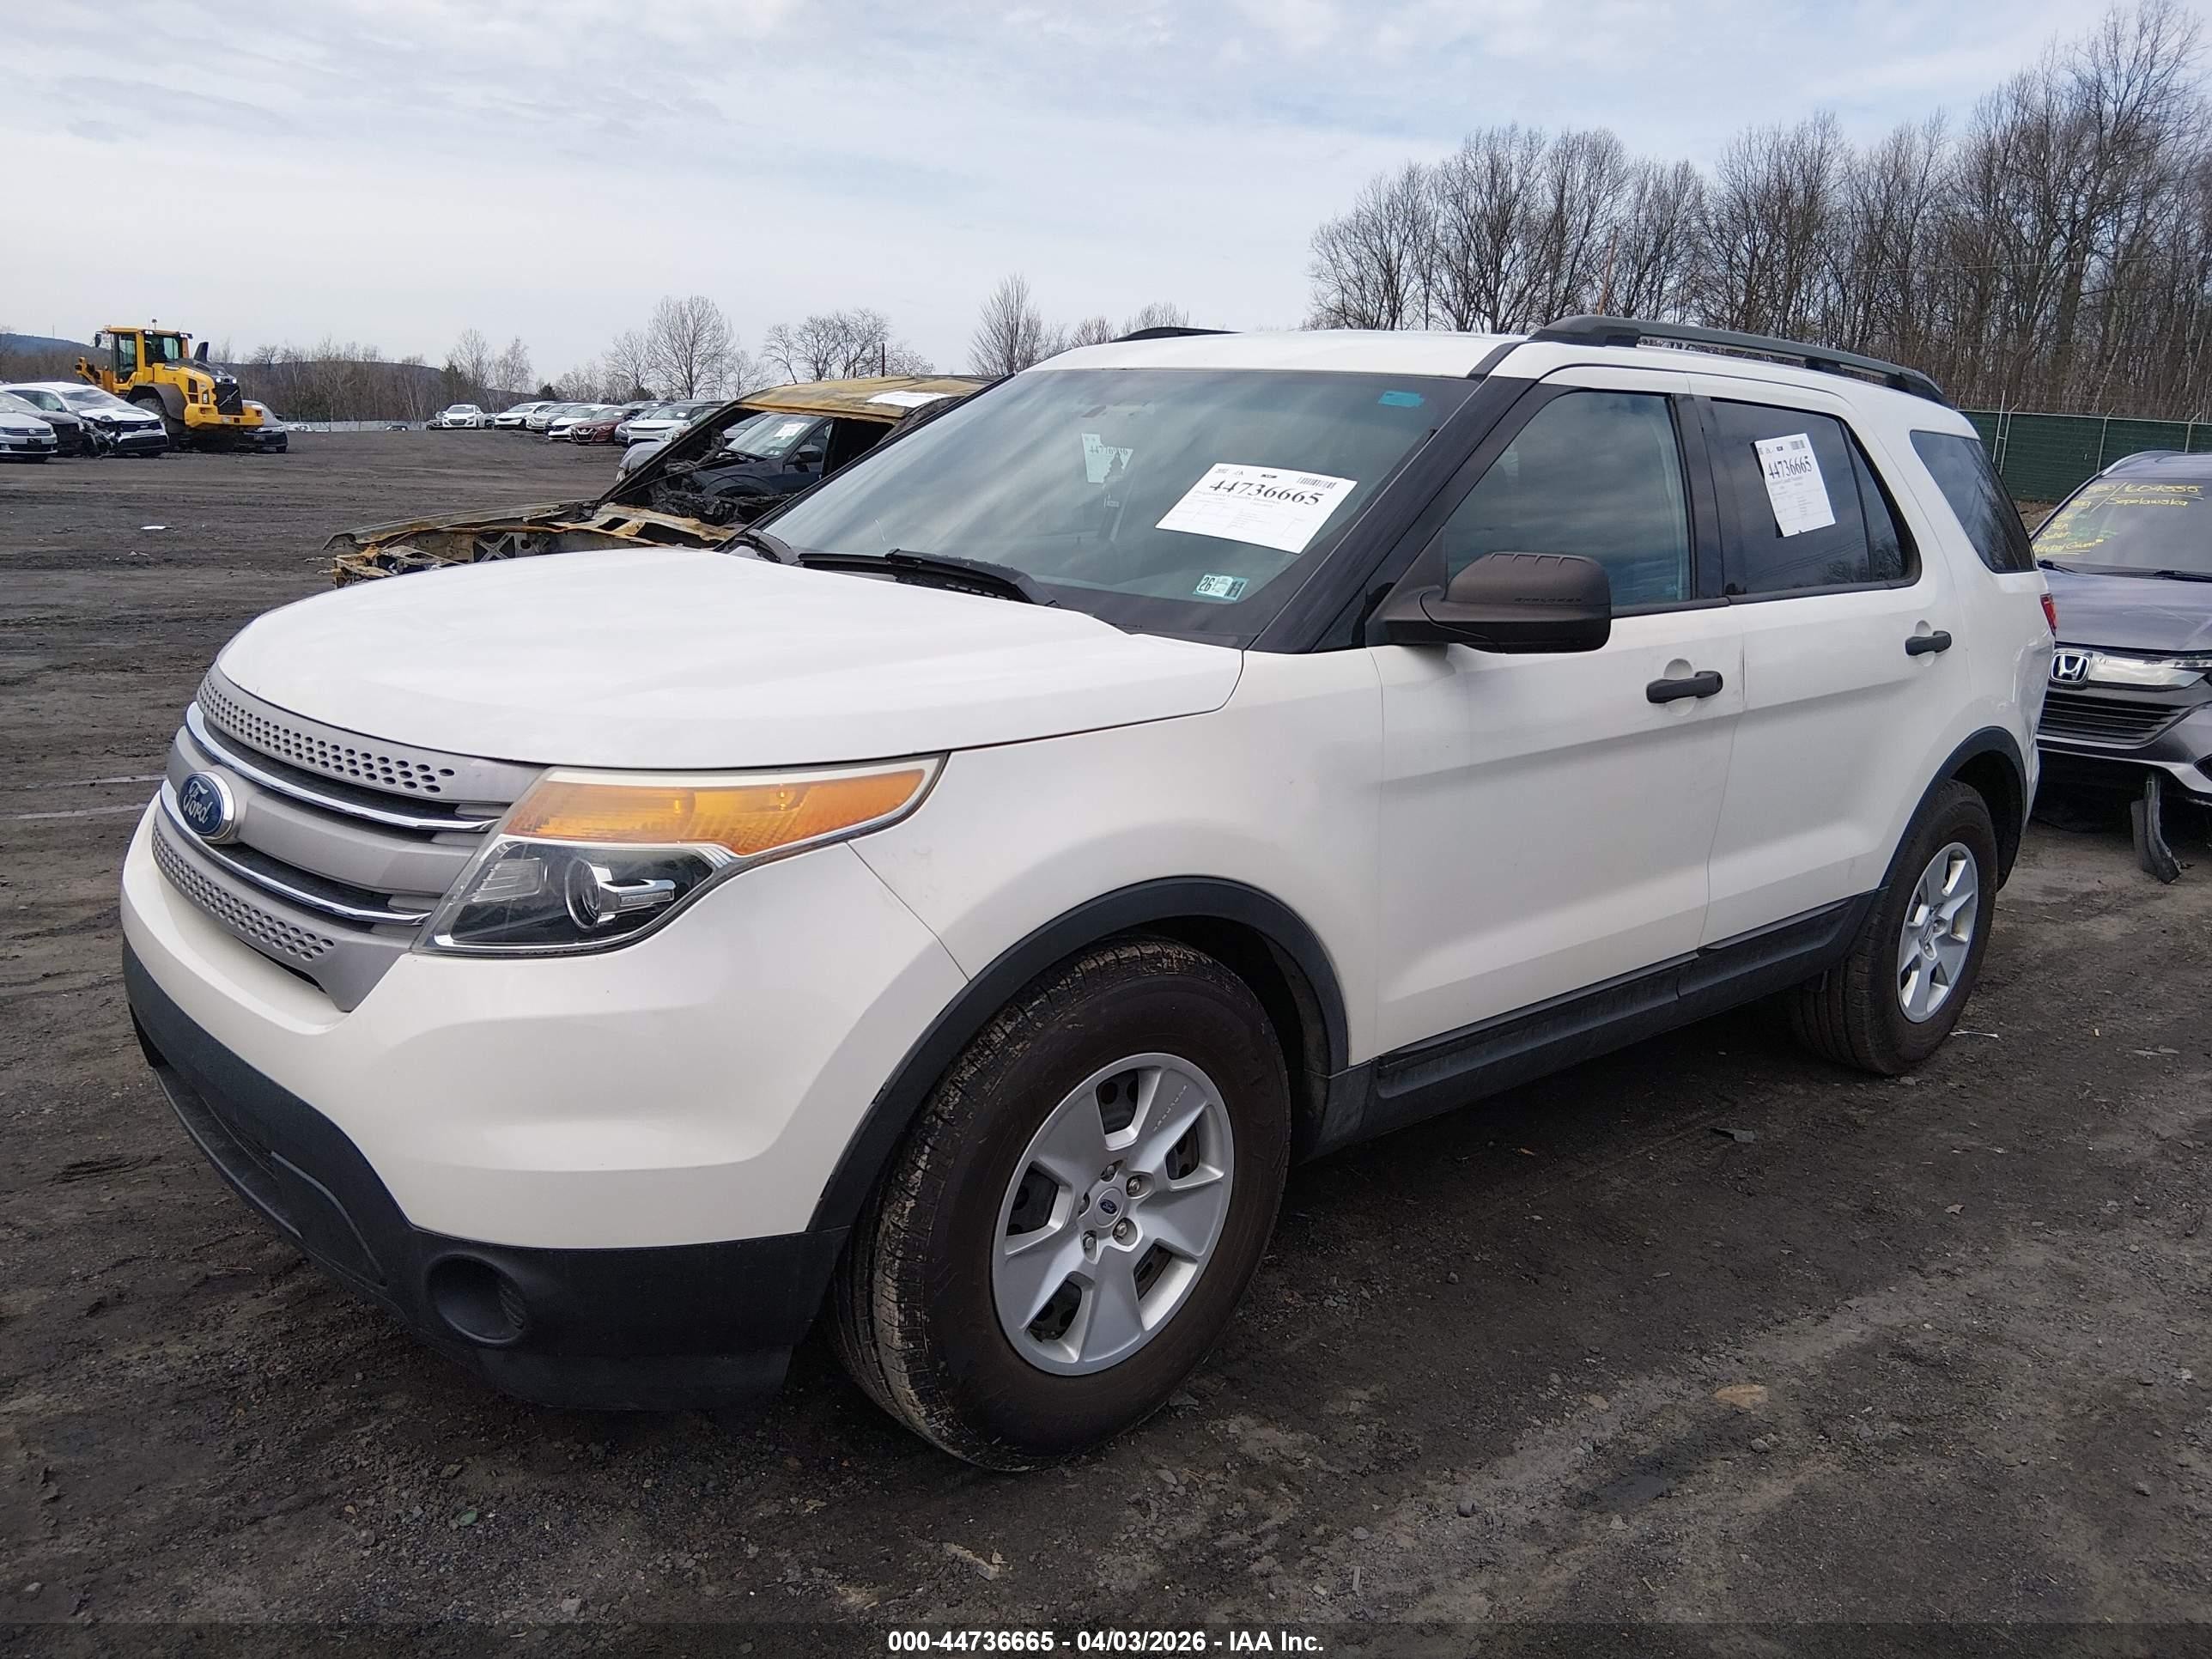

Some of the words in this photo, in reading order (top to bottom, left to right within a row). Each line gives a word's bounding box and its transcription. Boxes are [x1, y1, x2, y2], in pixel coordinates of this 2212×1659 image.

[1769, 455, 1813, 479] 44736665
[1209, 480, 1324, 506] 44736665
[1199, 576, 1216, 592] 26
[183, 781, 213, 824] Ford
